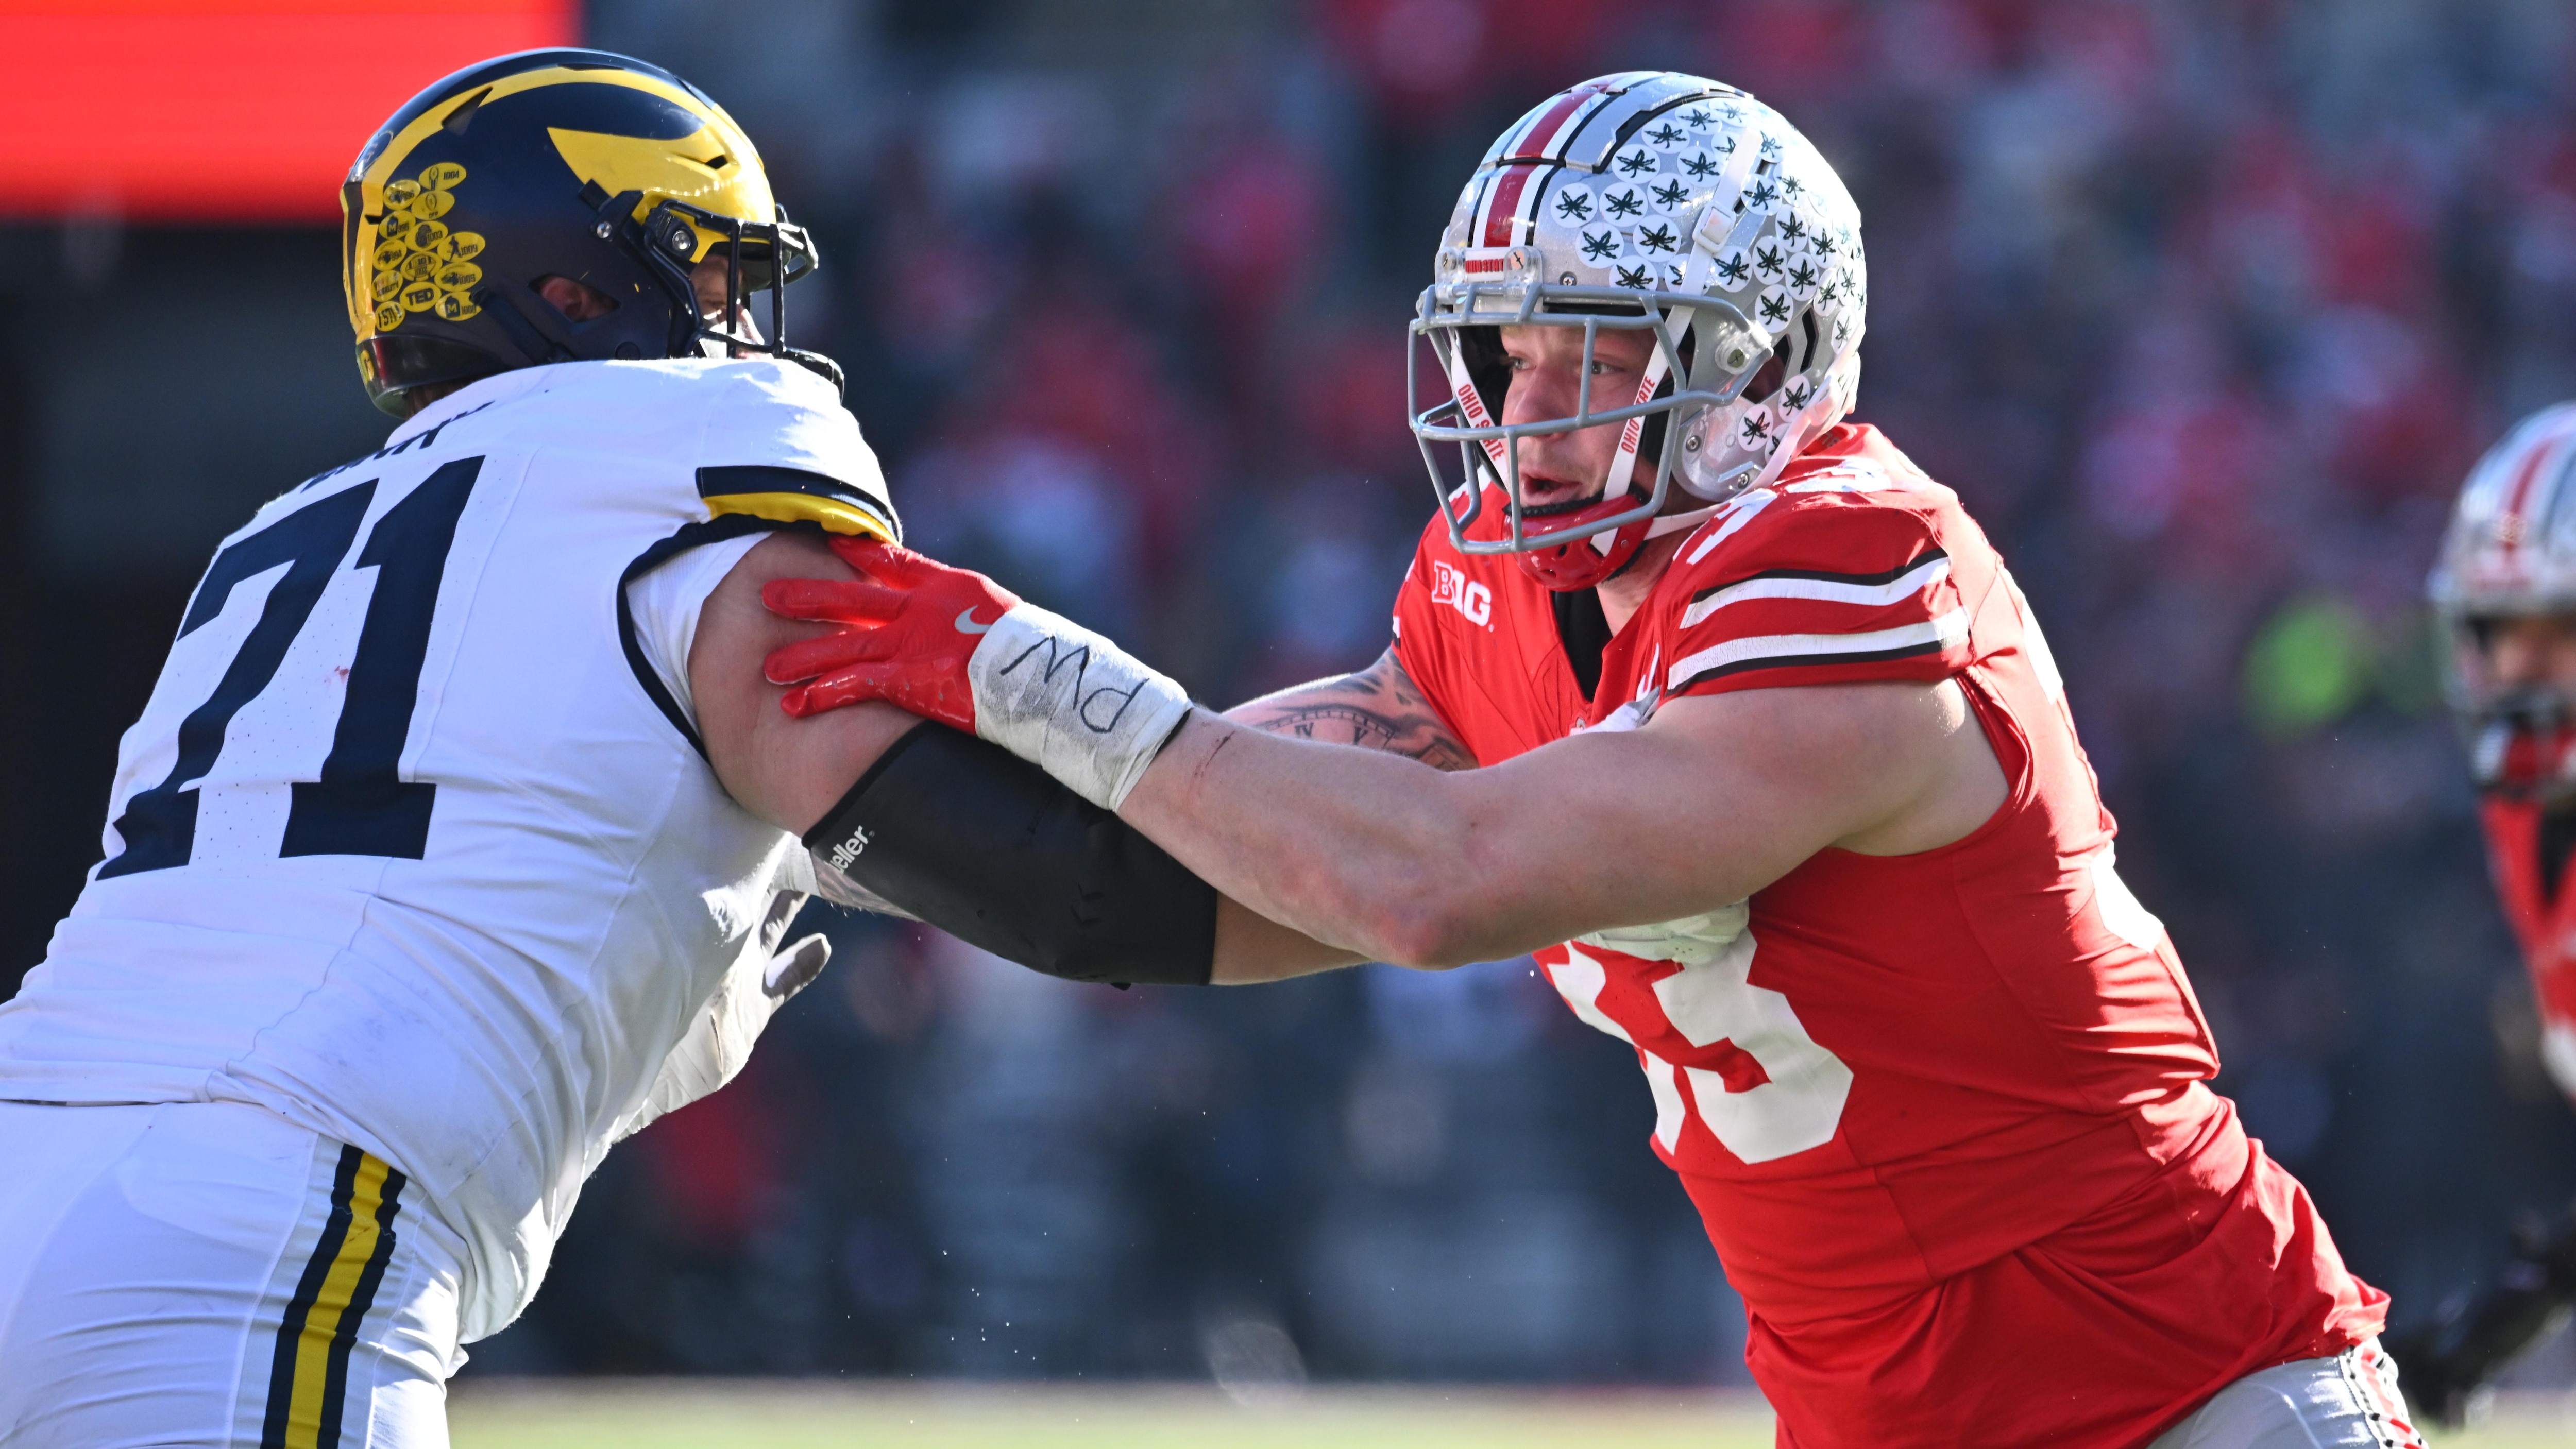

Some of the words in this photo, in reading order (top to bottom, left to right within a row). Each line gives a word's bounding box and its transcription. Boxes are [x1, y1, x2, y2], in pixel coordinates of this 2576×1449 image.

[444, 170, 460, 180] 1004
[461, 244, 478, 257] 1009
[1466, 260, 1482, 273] OHIO
[459, 274, 476, 284] 1005
[405, 288, 434, 306] TED
[1458, 384, 1483, 419] OHIO
[1475, 419, 1505, 461] SATE
[1621, 418, 1639, 454] OHIO
[95, 455, 486, 881] 71
